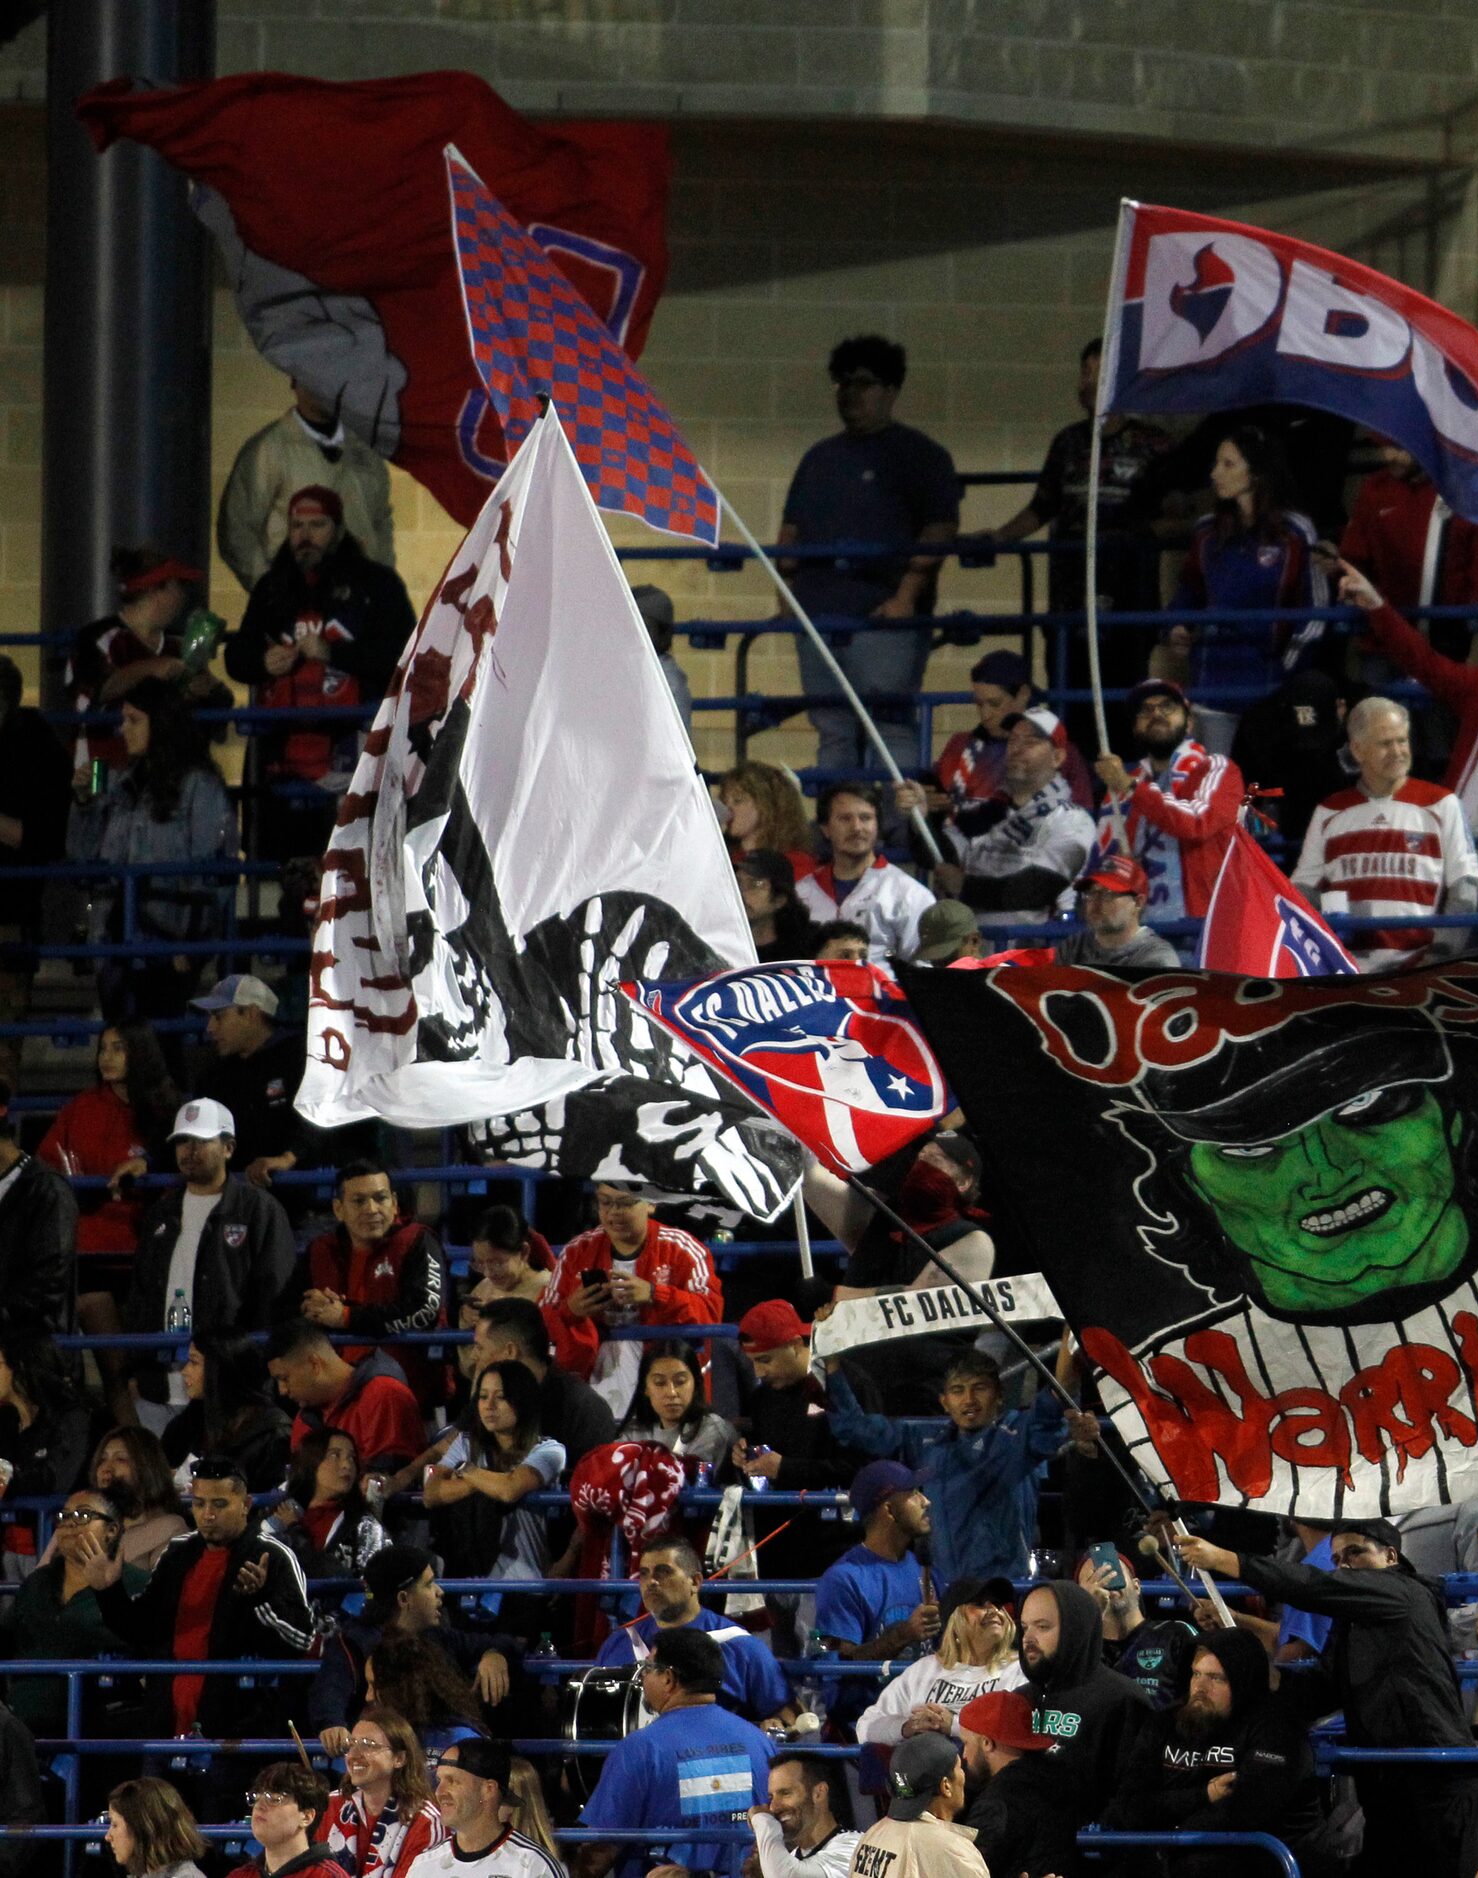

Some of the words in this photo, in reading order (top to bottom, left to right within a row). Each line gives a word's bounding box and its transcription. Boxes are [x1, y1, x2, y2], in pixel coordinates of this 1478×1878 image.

[1341, 858, 1357, 877] FC
[1361, 853, 1416, 877] DALLAS
[690, 991, 750, 1041] FC
[427, 1252, 442, 1289] AIR
[878, 1294, 915, 1328] FC
[916, 1281, 1016, 1323] DALLAS
[925, 1677, 1001, 1705] EVERLAST
[1164, 1744, 1235, 1768] NARS
